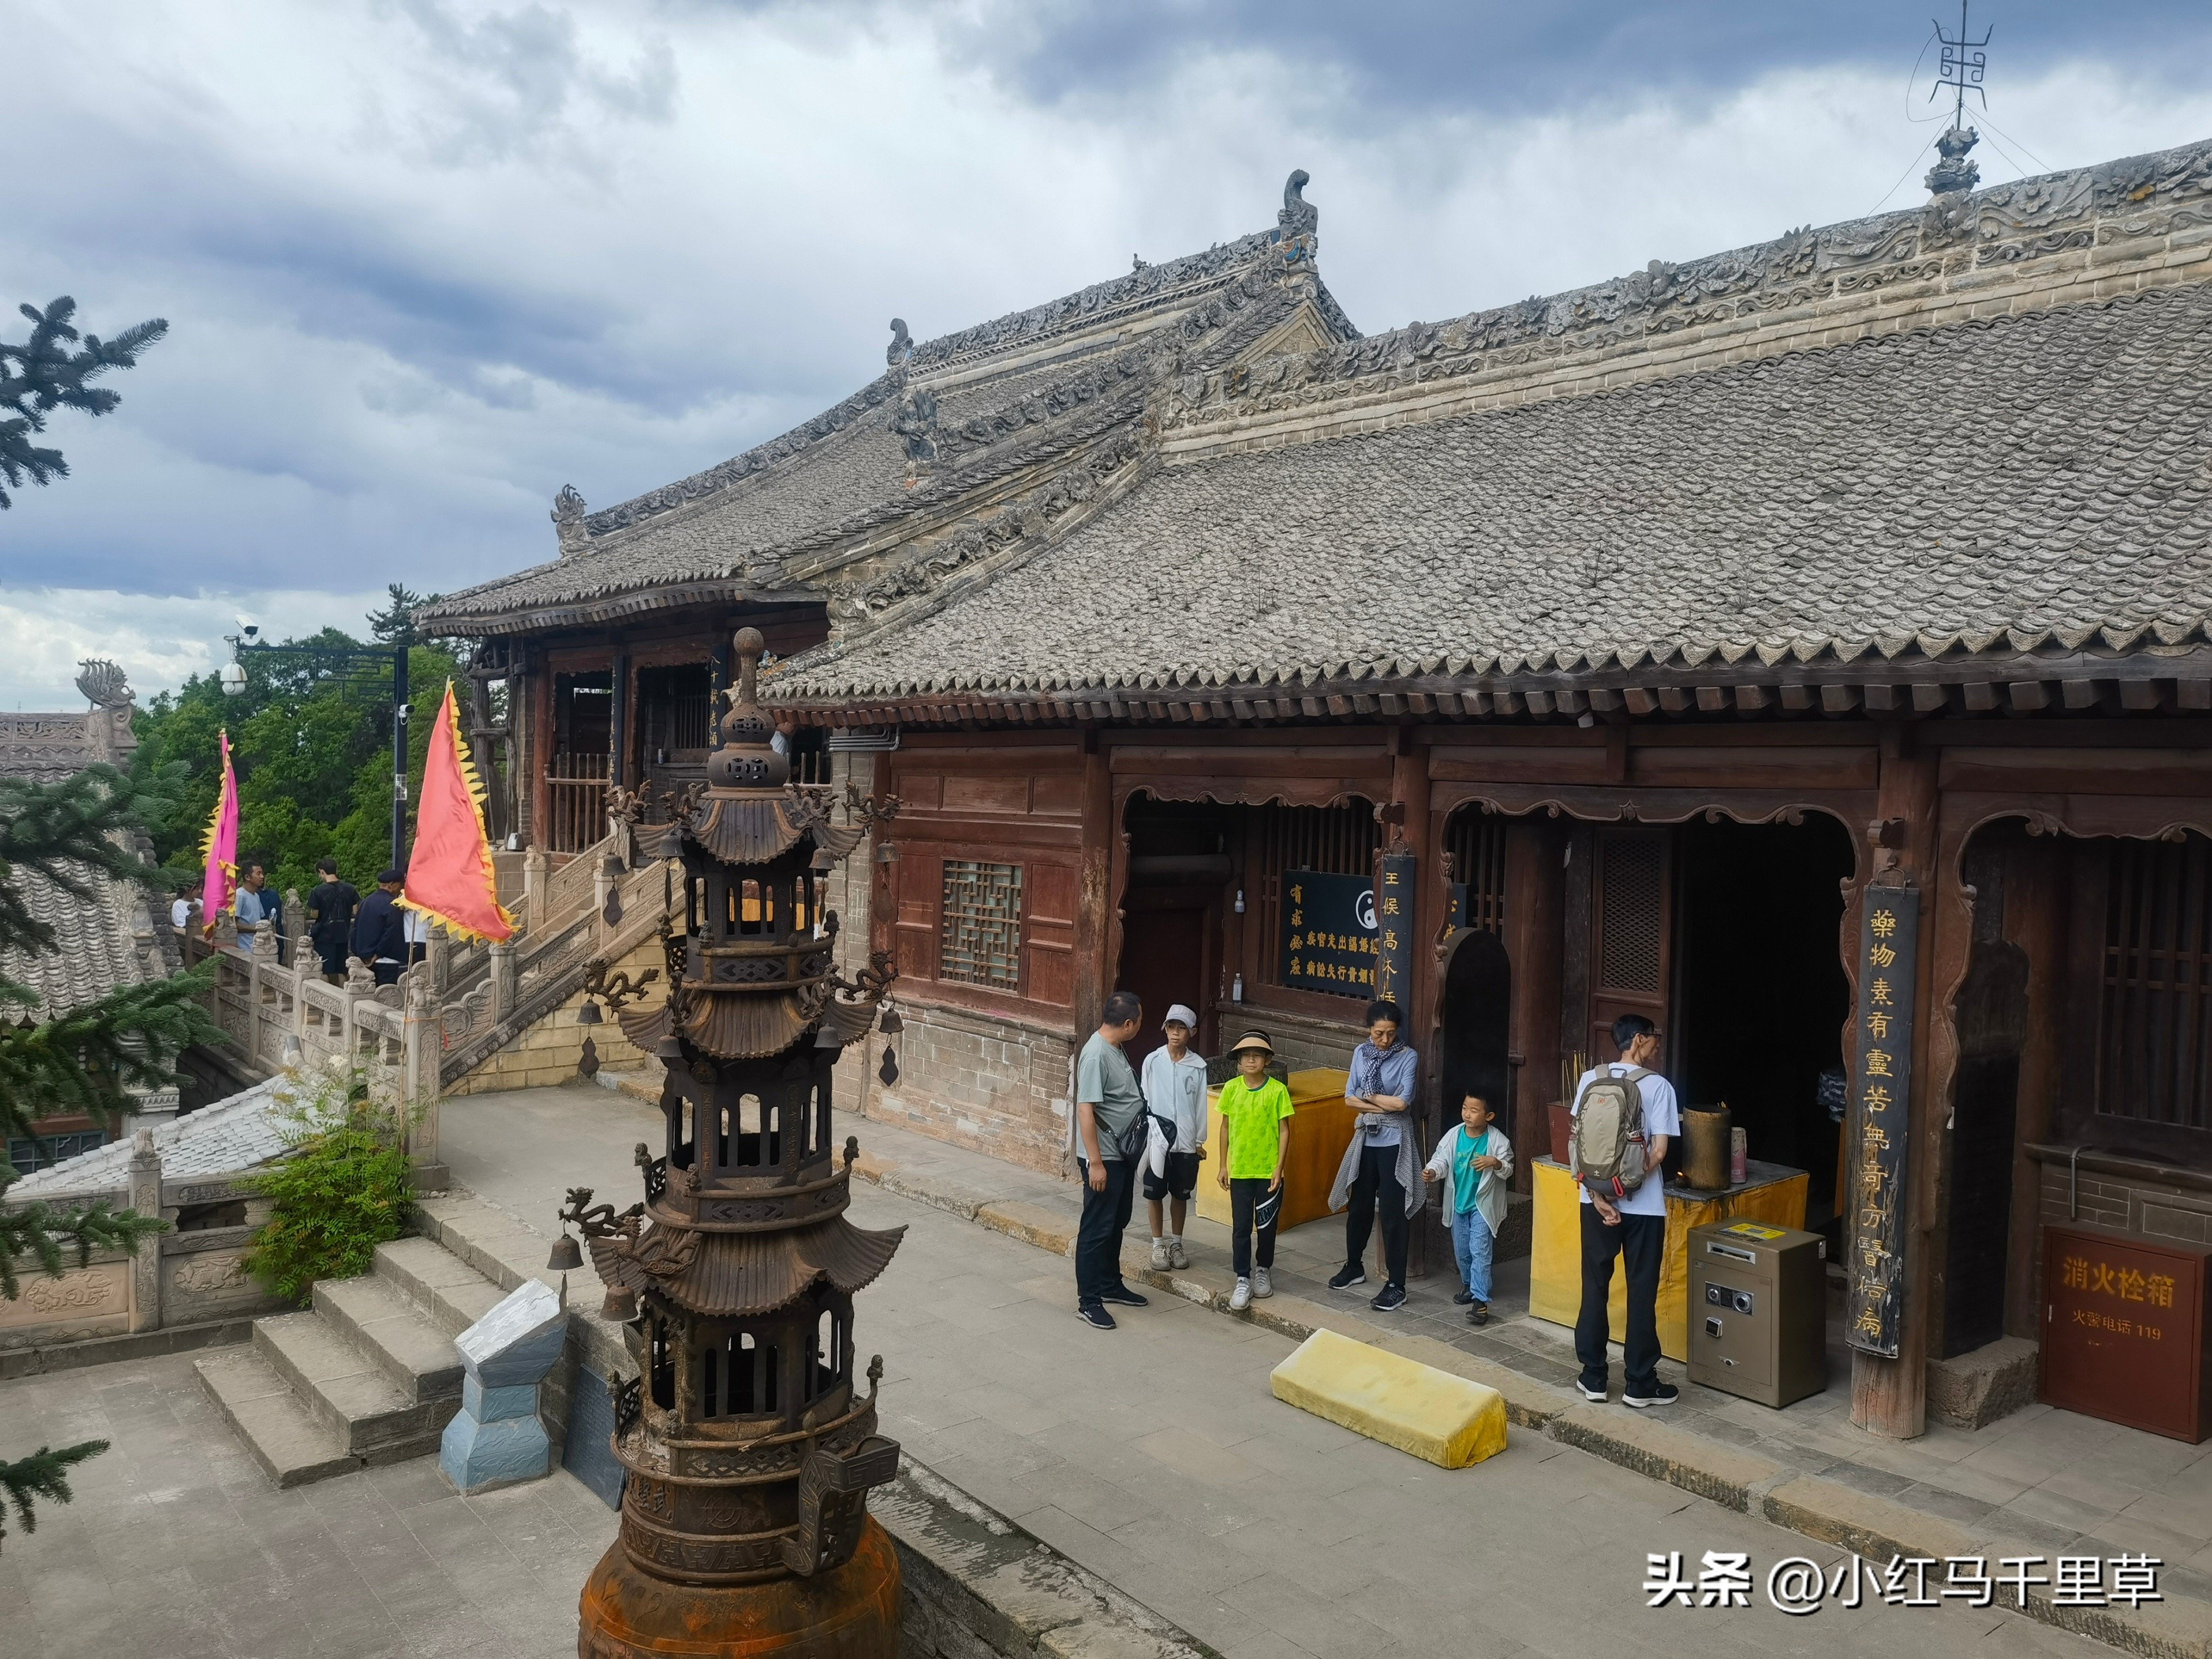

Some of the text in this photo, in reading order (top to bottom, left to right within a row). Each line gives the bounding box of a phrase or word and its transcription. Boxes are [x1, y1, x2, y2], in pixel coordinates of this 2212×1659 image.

[2063, 1256, 2176, 1308] 消火栓箱
[2073, 1308, 2161, 1341] 火警电话 119
